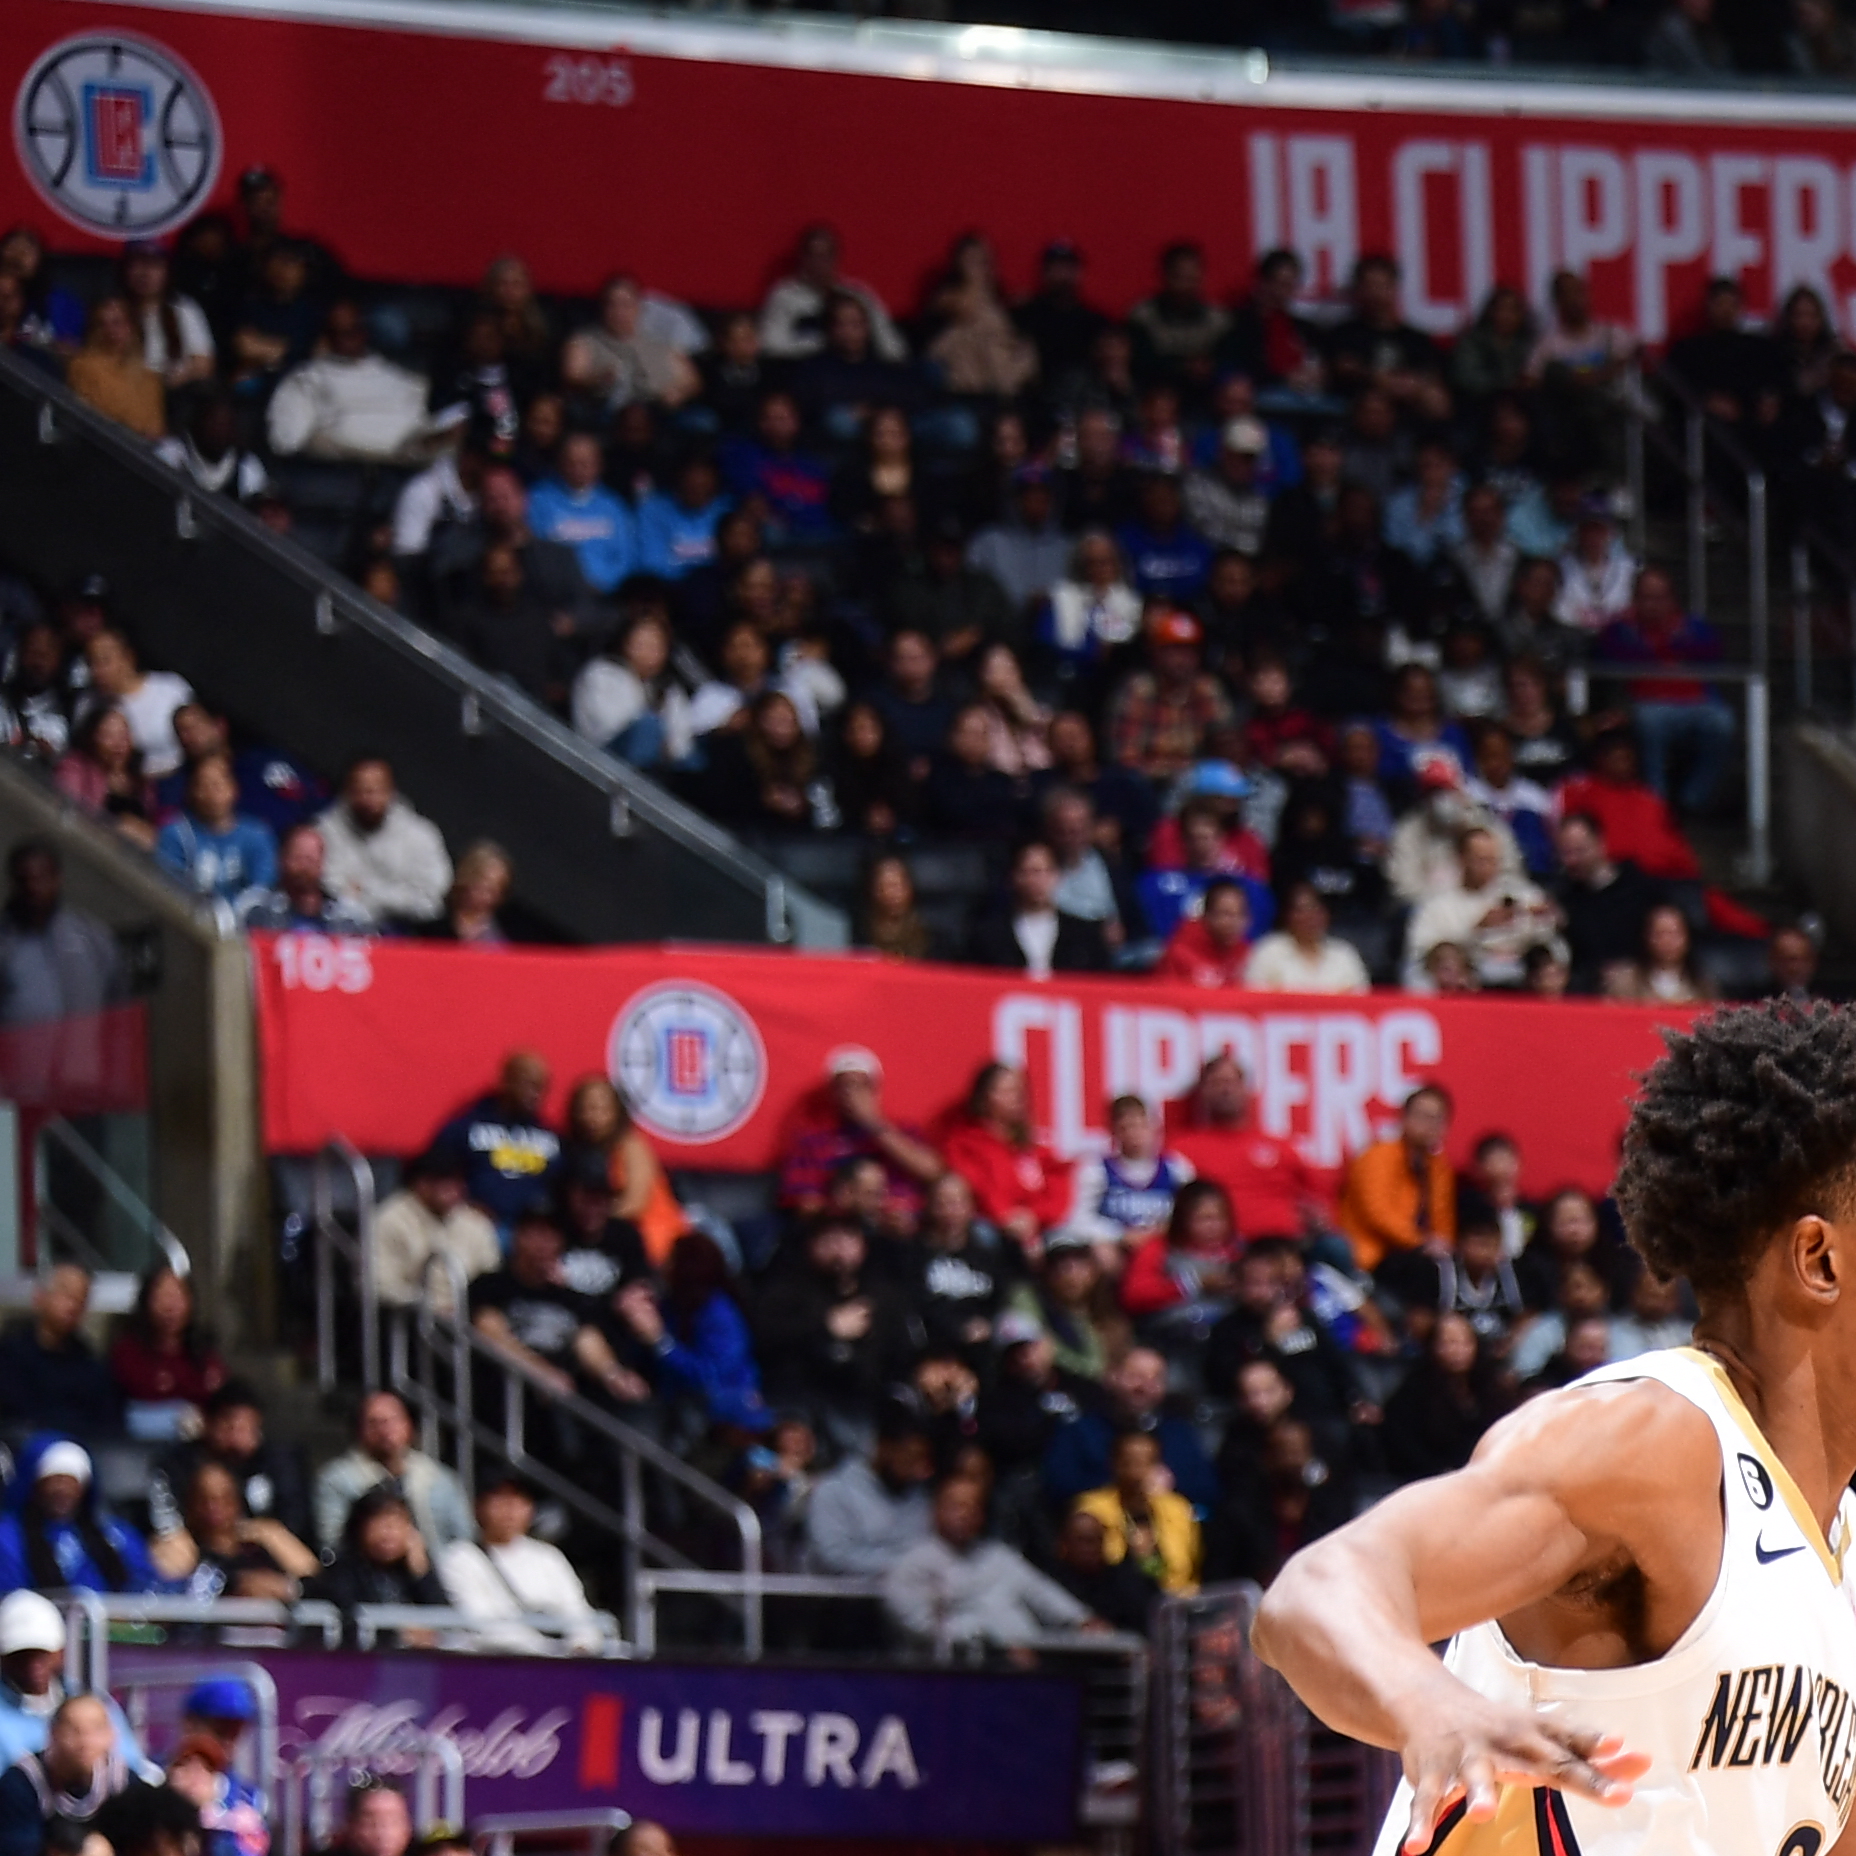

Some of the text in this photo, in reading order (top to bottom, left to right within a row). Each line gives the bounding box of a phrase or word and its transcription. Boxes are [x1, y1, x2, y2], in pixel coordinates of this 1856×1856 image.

[543, 56, 634, 107] 205
[272, 935, 372, 994] 105
[638, 1705, 922, 1788] ULTRA
[1687, 1663, 1815, 1773] NEW
